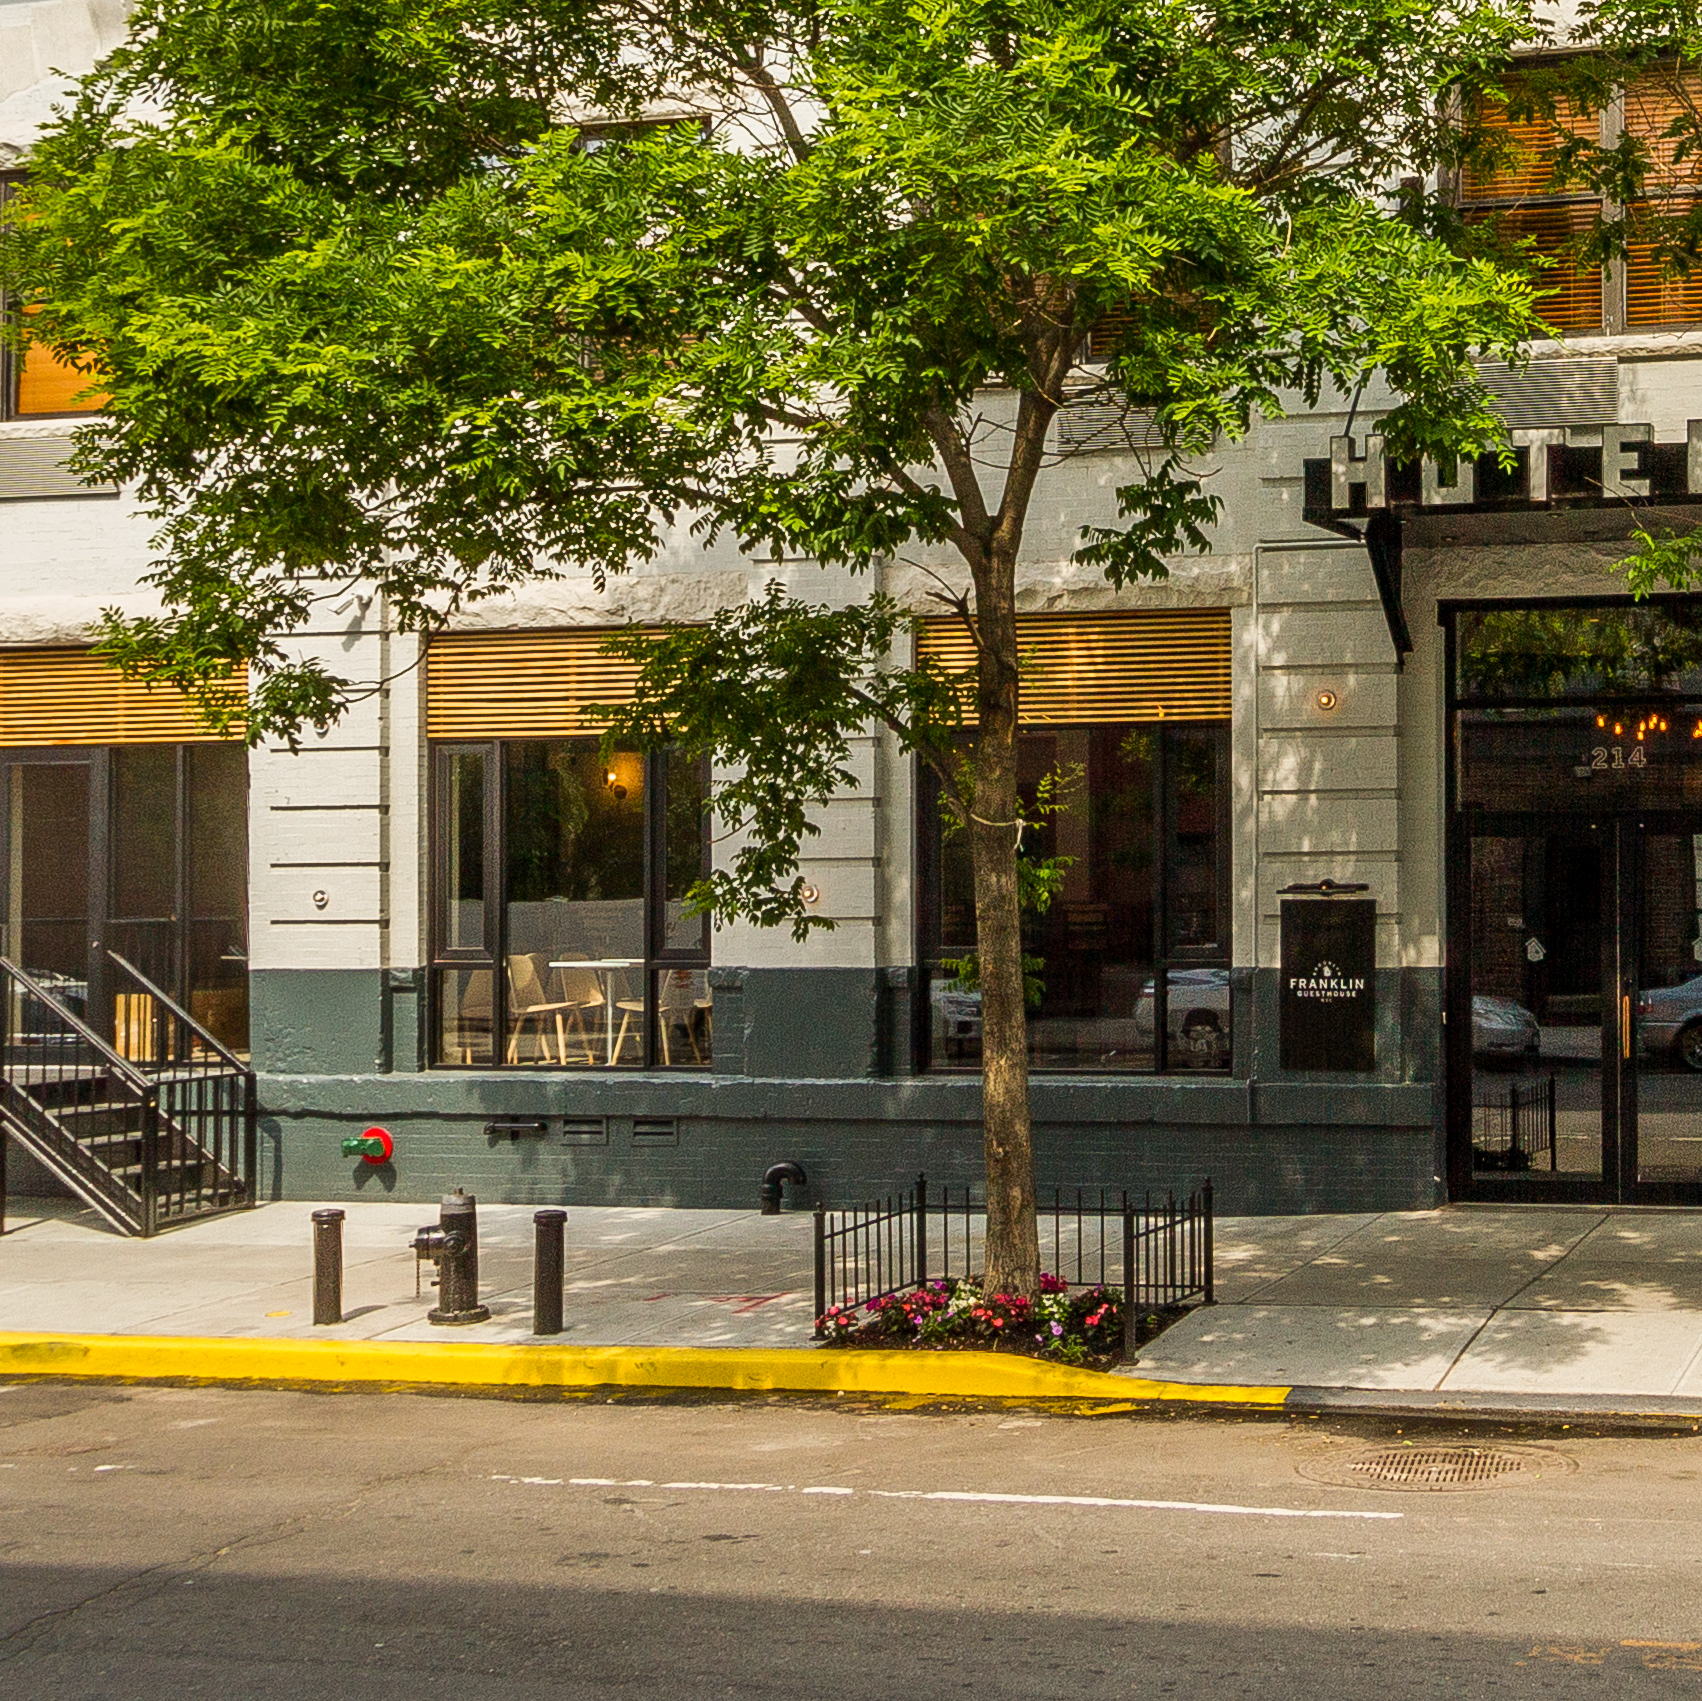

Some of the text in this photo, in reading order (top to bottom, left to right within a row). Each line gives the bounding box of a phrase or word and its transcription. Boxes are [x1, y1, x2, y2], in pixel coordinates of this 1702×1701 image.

[1591, 746, 1647, 769] 214
[1289, 978, 1365, 990] FRANKLIN
[1296, 990, 1357, 998] GUESTHOUSE
